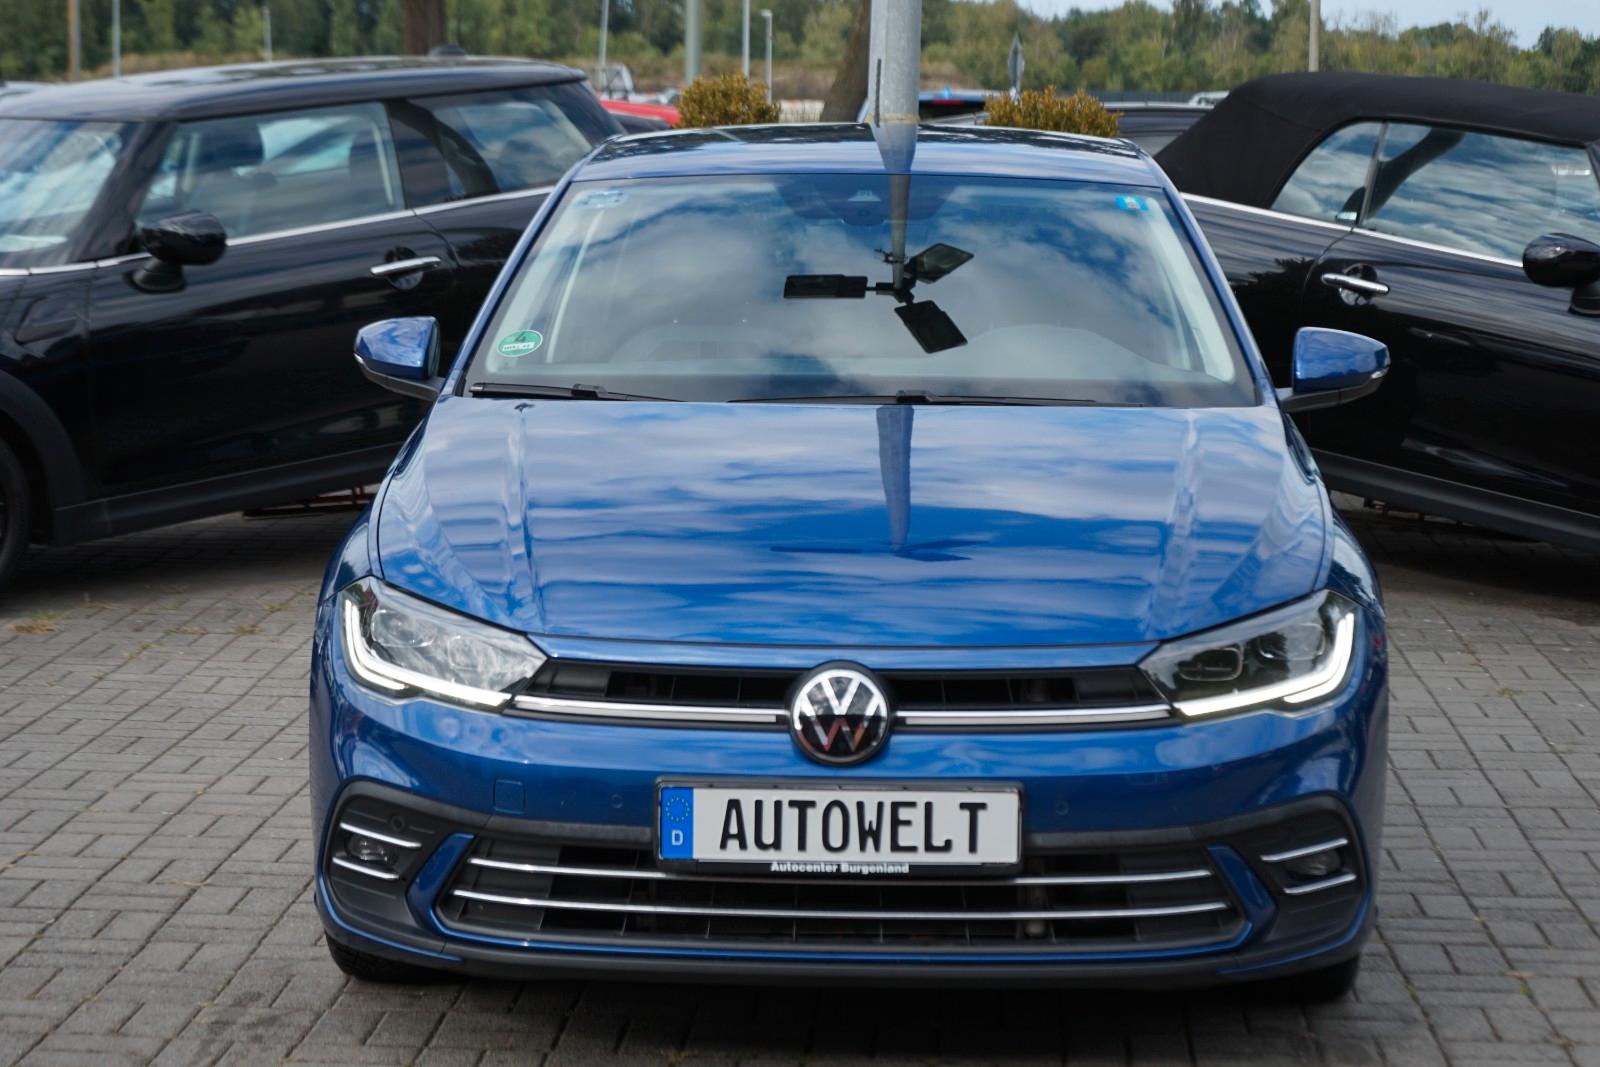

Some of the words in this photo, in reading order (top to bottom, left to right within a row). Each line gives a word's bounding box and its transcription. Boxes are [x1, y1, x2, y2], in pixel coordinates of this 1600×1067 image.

[719, 798, 988, 854] AUTOWELT
[671, 829, 684, 847] D
[770, 861, 838, 874] Autocenter
[841, 862, 910, 875] Burgenland
